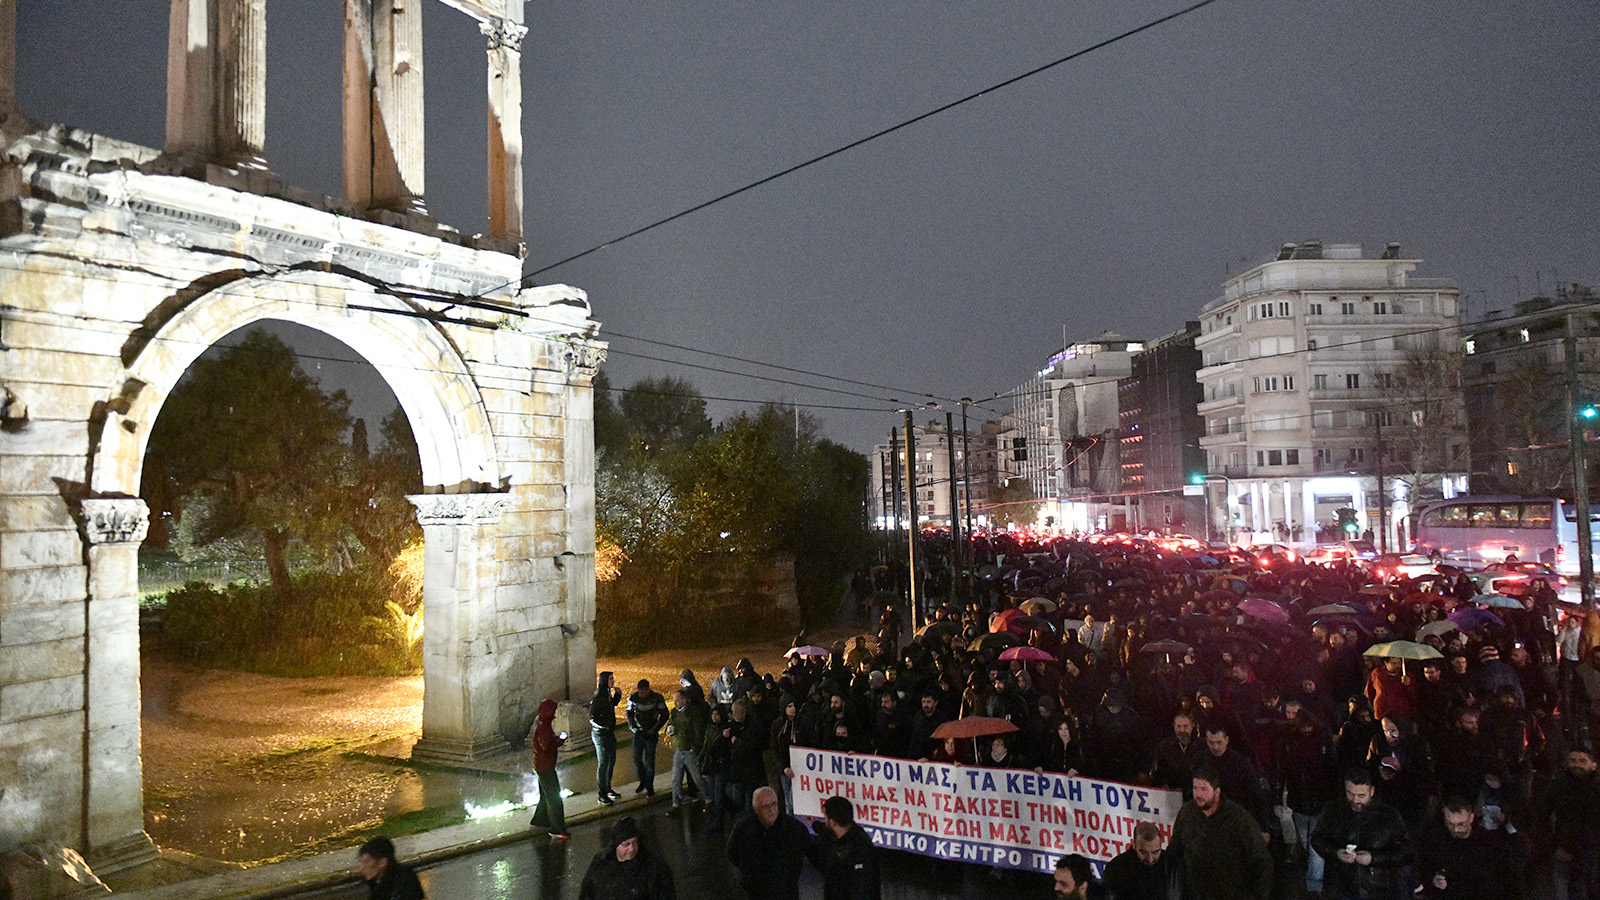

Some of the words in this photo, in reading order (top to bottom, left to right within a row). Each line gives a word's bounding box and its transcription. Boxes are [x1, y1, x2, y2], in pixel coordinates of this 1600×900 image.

[800, 774, 811, 791] Η
[815, 777, 856, 798] ΟΡΓΗ
[861, 783, 899, 803] ΜΑΣ
[904, 787, 927, 808] ΝΑ
[932, 792, 1020, 819] ΤΣΑΚΙΣΕΙ
[1026, 801, 1068, 825] ΤΗΝ
[1073, 808, 1172, 846] ΠΟΛΙΤΗ
[806, 753, 823, 772] ΟΙ
[831, 755, 901, 782] ΝΕΚΡΟΙ
[908, 764, 957, 794] ΜΑΣ,
[966, 770, 997, 792] ΤΑ
[1006, 773, 1082, 802] ΚΕΡΔΗ
[1091, 783, 1160, 815] ΤΟΥΣ.
[855, 803, 912, 828] ΜΕΤΡΑ
[917, 812, 938, 832] ΤΗ
[943, 817, 982, 839] ΖΩΗ
[988, 822, 1031, 845] ΜΑΣ
[1039, 828, 1065, 850] ΩΣ
[934, 840, 1022, 866] ΚΕΝΤΡΟ
